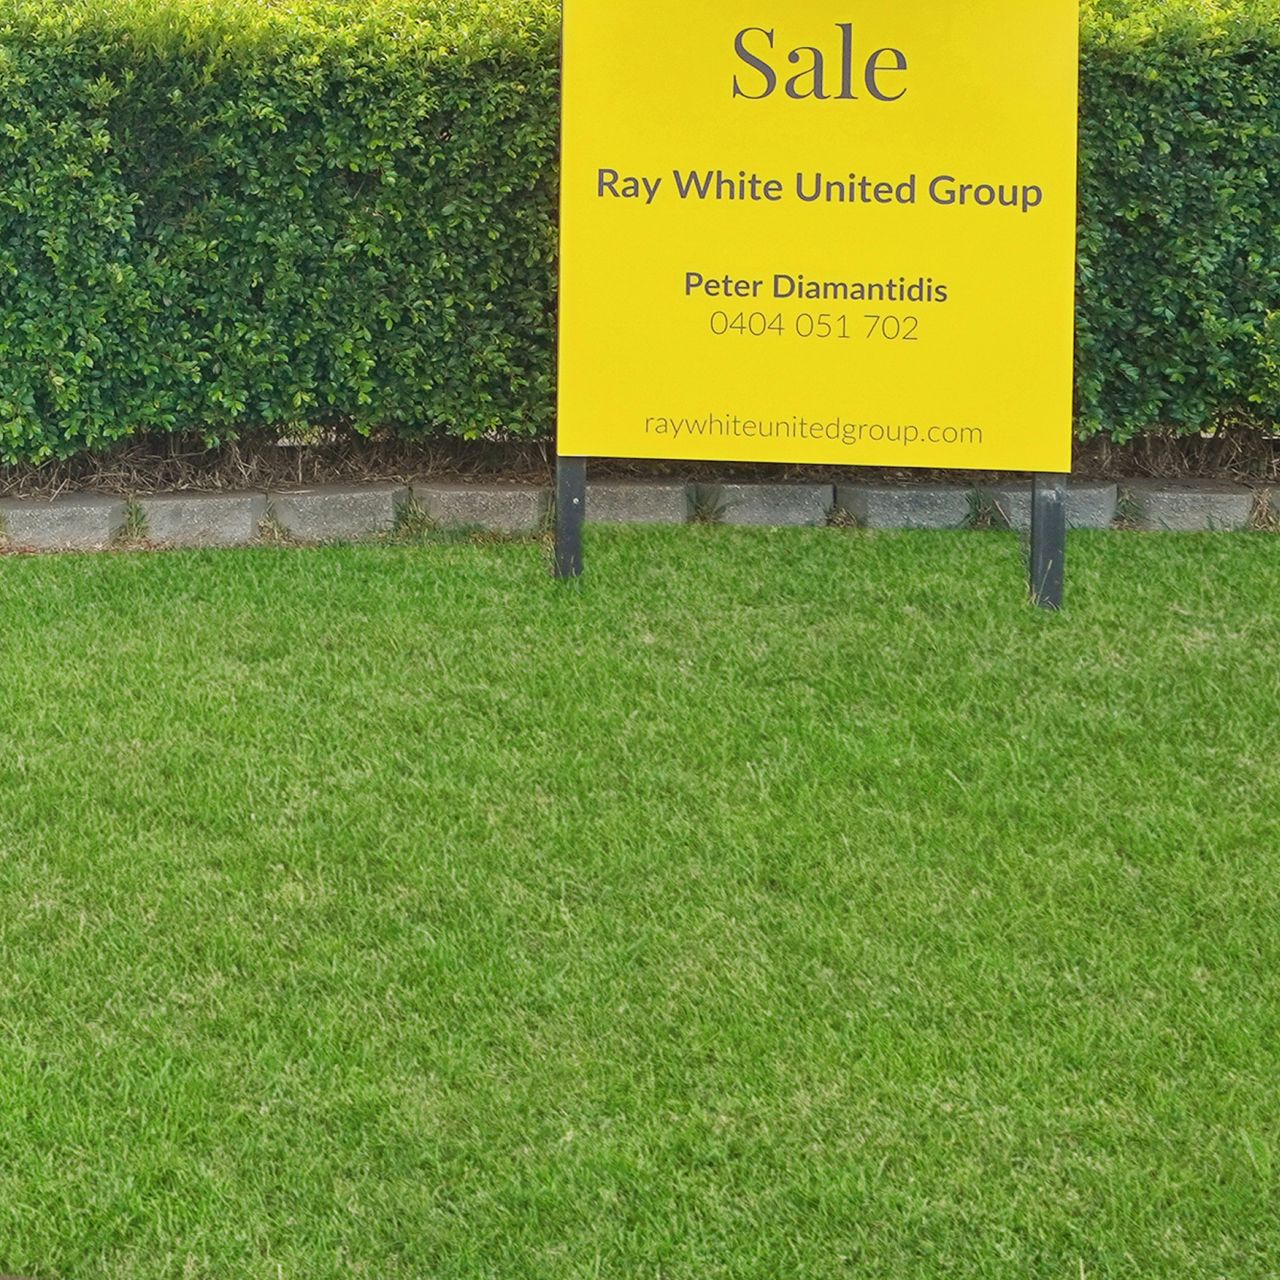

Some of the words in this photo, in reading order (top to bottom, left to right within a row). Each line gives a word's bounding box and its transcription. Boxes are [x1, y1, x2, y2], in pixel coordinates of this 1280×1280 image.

[732, 22, 909, 103] Sale
[597, 168, 662, 205] Ray
[673, 169, 784, 202] White
[796, 172, 917, 204] United
[928, 175, 1044, 213] Group
[684, 271, 764, 299] Peter
[773, 273, 949, 303] Diamantidis
[710, 311, 786, 338] 0404
[796, 313, 851, 340] 051
[864, 314, 919, 342] 702
[644, 413, 984, 447] raywhiteunitedgroup.com
